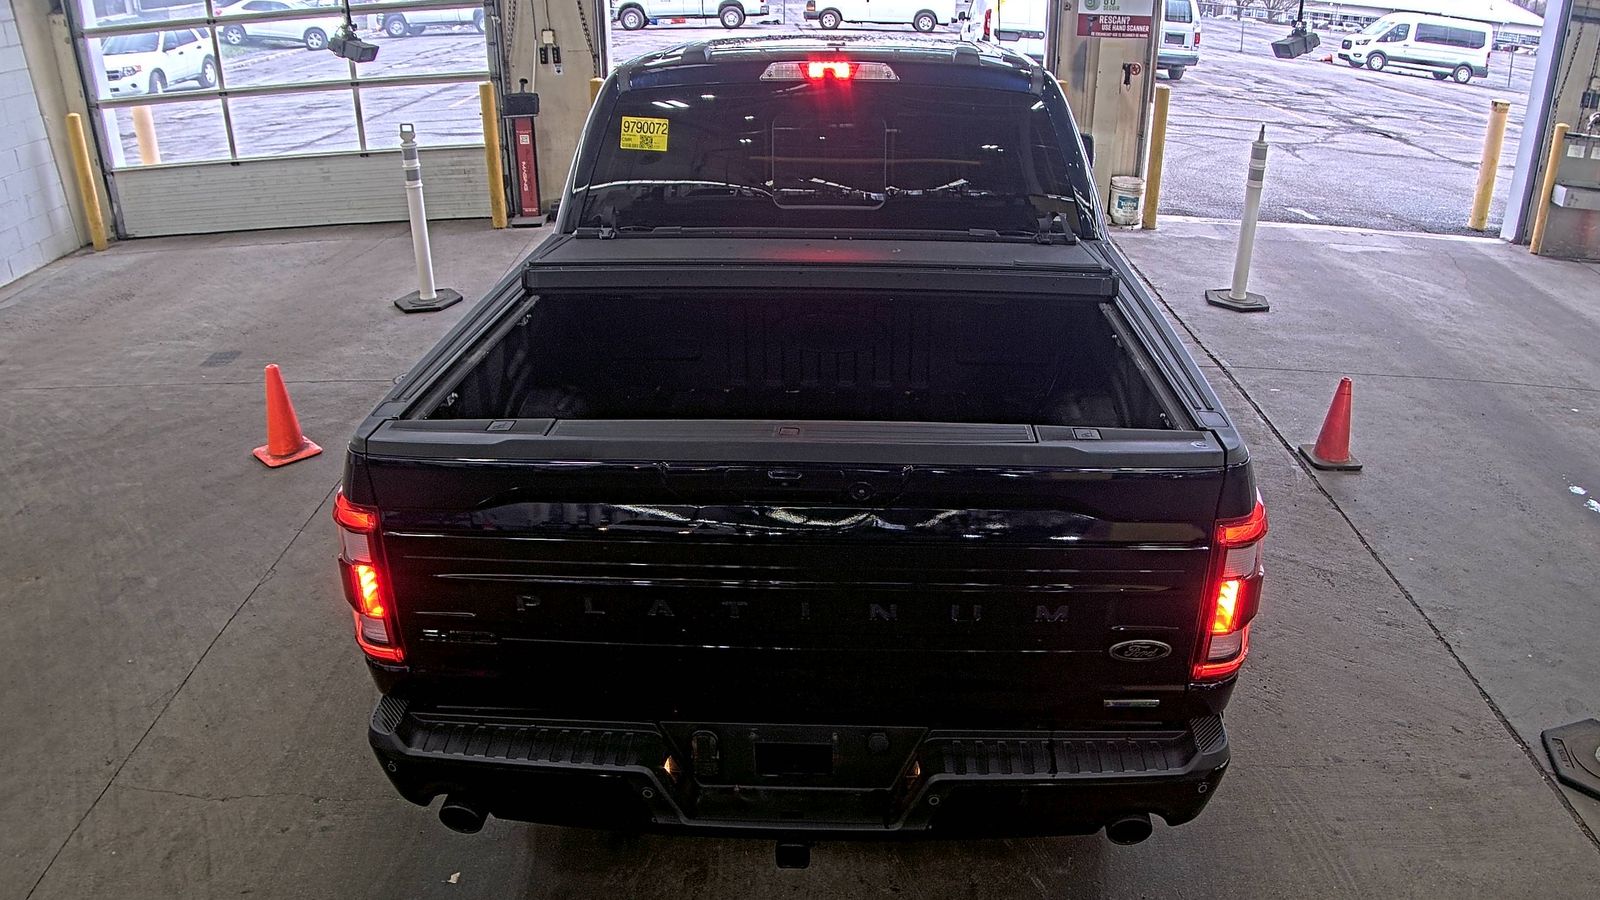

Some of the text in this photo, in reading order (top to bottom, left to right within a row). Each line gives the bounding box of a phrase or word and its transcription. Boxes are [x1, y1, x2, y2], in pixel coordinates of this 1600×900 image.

[1099, 16, 1130, 24] RESCAN?
[623, 120, 668, 135] 9790072
[516, 594, 1070, 623] PLATINUM
